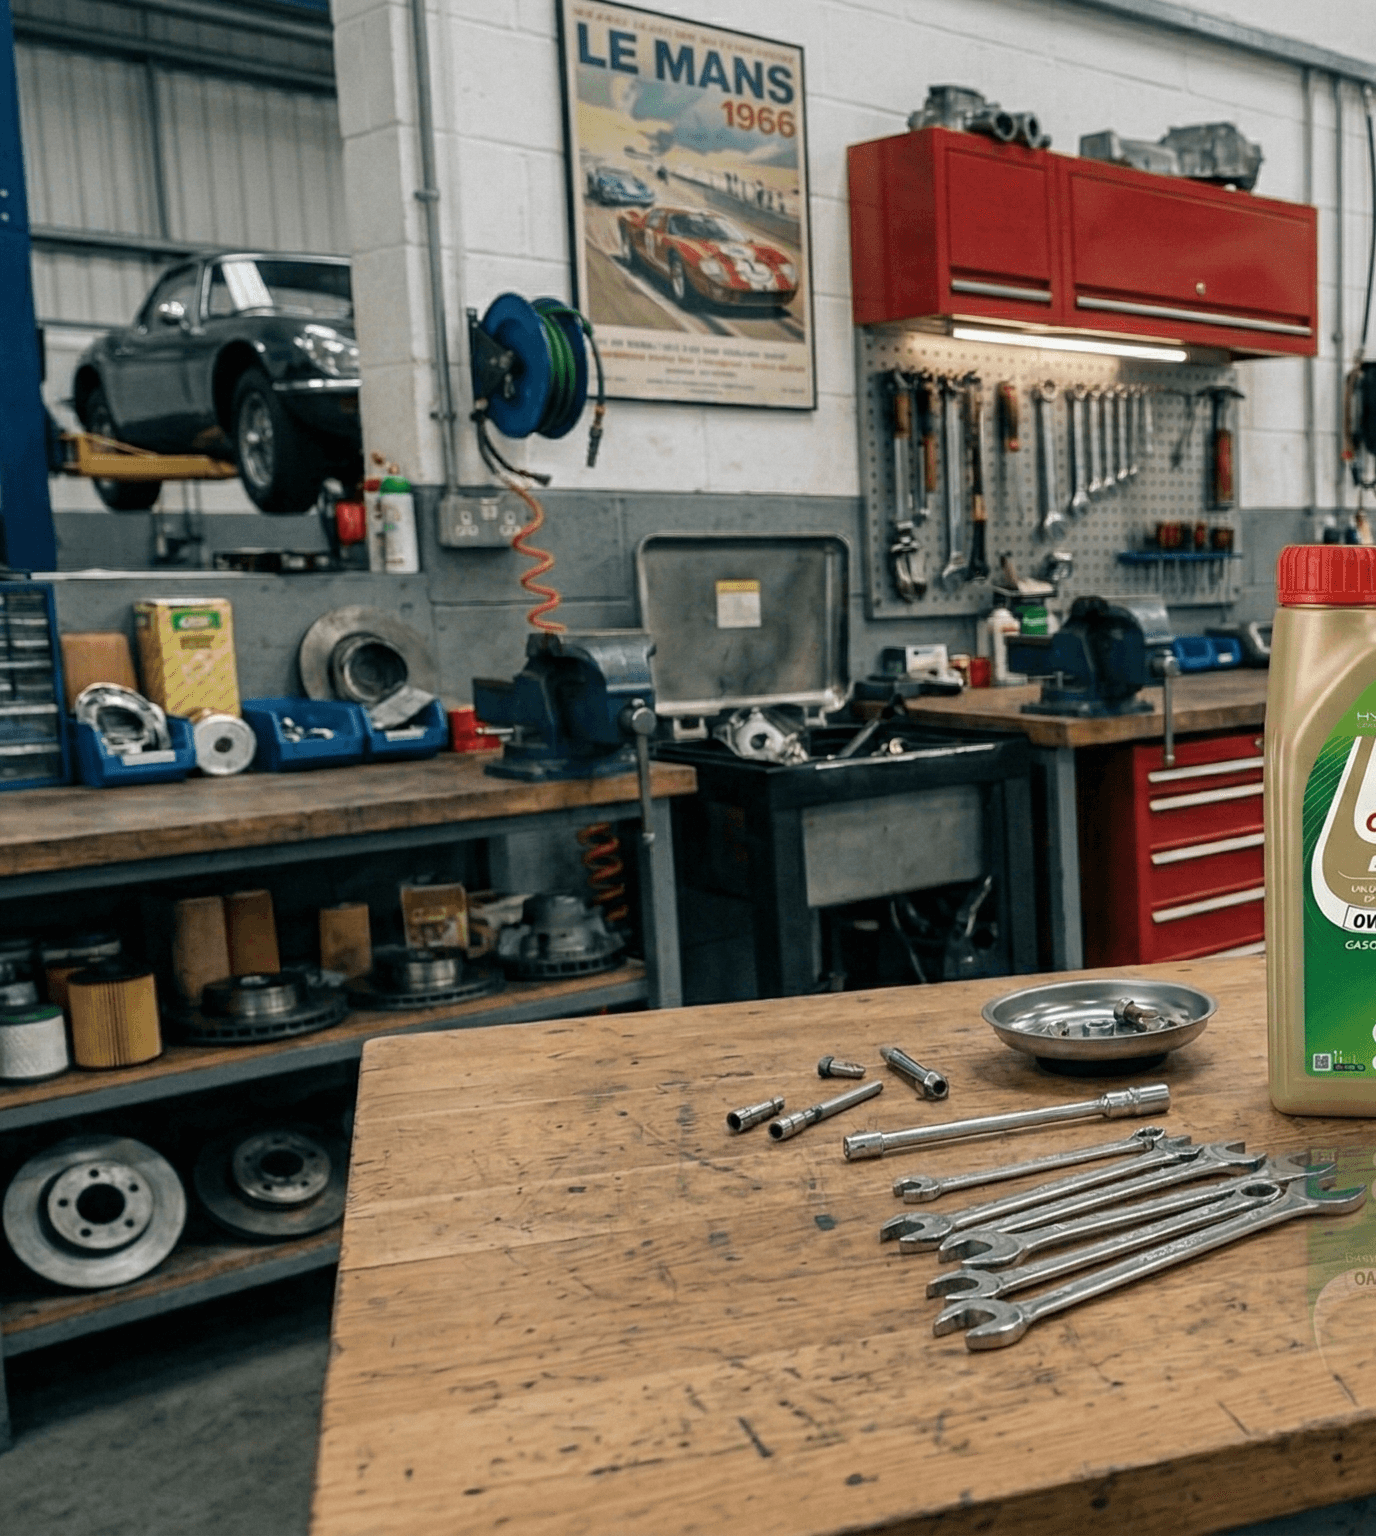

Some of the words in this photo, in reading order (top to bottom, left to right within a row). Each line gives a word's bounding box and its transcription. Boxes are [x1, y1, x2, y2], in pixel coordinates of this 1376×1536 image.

[577, 21, 639, 75] LE
[654, 39, 795, 105] MANS
[721, 100, 796, 138] 1966
